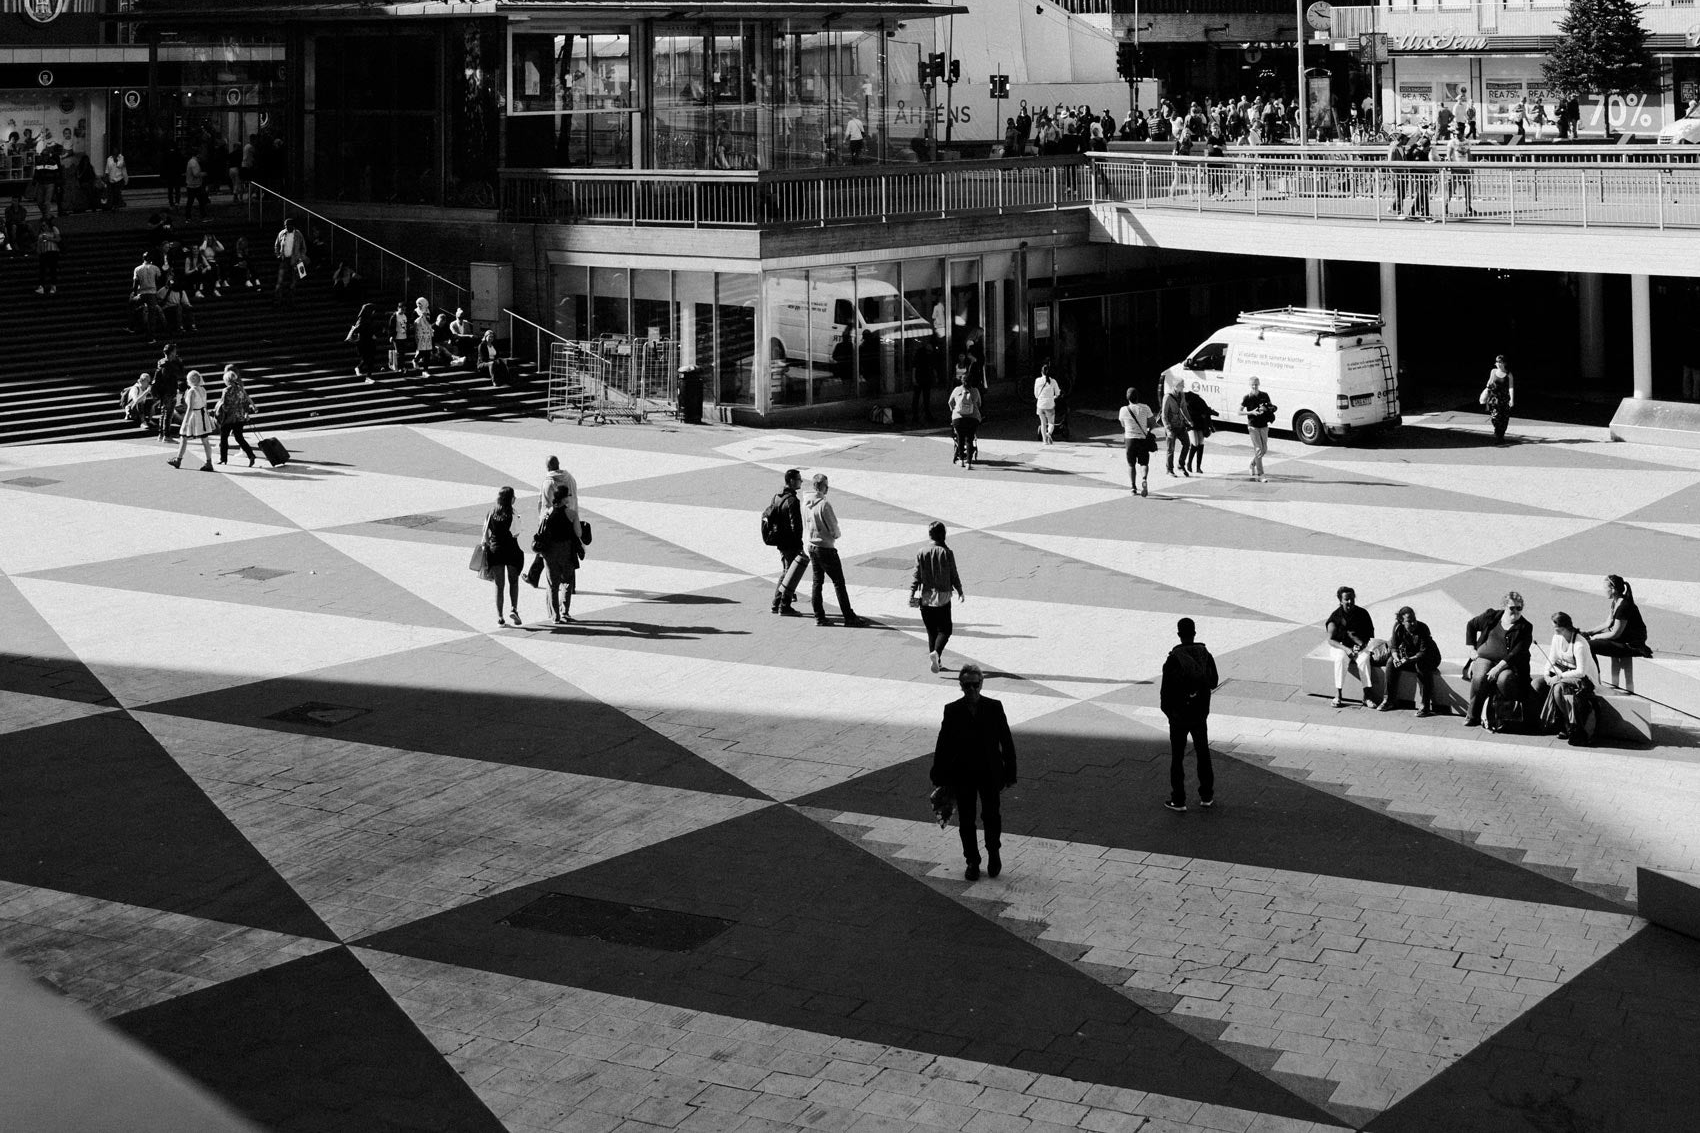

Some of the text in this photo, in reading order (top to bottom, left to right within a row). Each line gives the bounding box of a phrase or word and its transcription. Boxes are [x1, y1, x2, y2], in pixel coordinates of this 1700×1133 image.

[1418, 93, 1432, 101] 75%
[1488, 90, 1520, 98] REA 75%
[1528, 90, 1545, 98] REA
[1588, 94, 1652, 127] 70%
[1201, 384, 1221, 394] MTR
